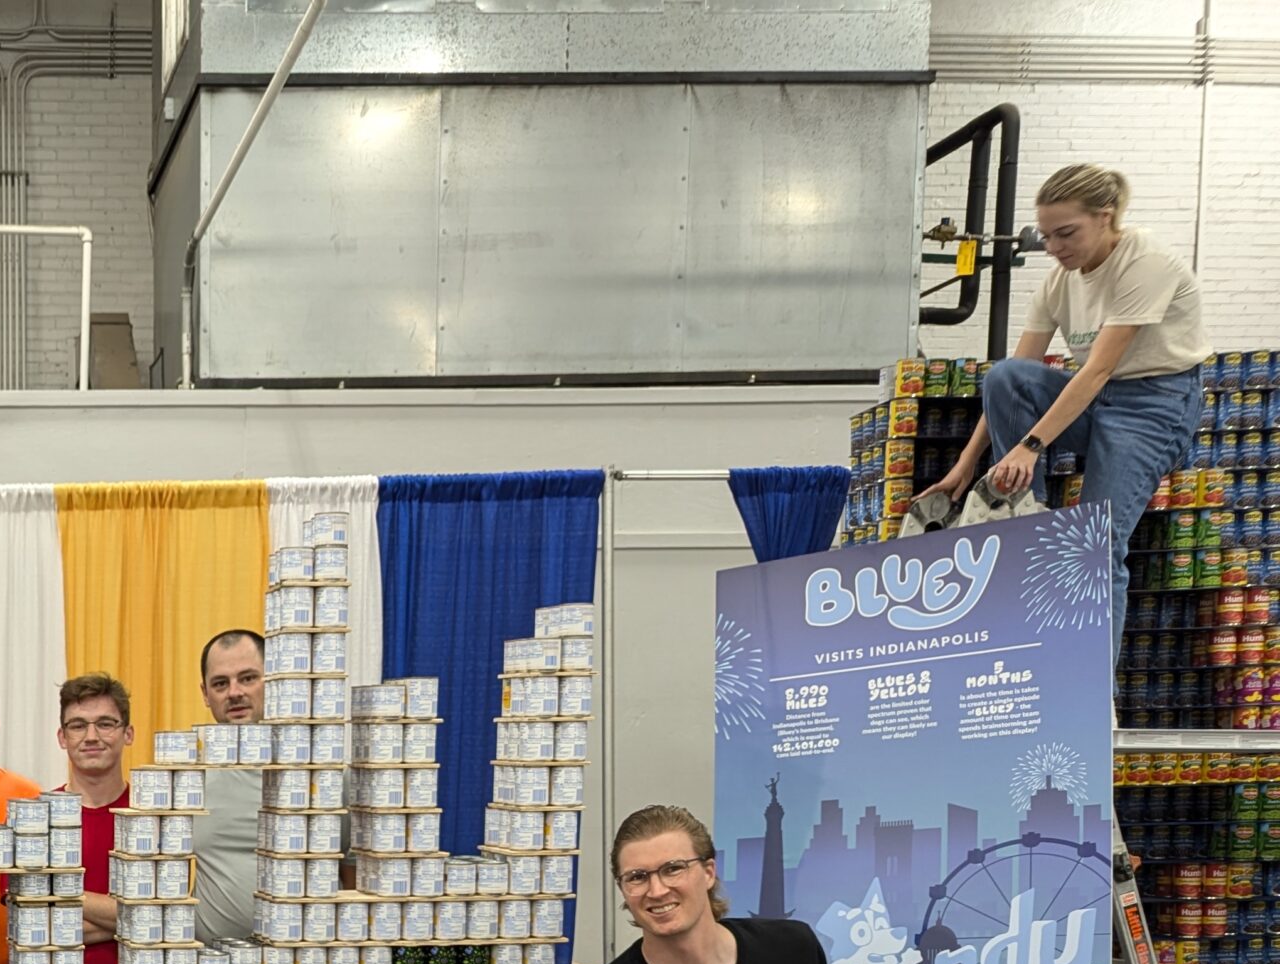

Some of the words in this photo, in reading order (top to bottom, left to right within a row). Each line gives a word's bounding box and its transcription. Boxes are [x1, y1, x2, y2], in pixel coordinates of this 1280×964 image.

[805, 535, 1000, 631] BLUEY
[815, 649, 864, 664] VISITS
[870, 630, 989, 657] INDIANAPOLIS
[994, 661, 1004, 674] 5
[868, 673, 915, 690] BLUES
[920, 670, 932, 683] &
[966, 670, 1032, 688] MONTHS
[785, 685, 828, 700] 8,990
[870, 683, 930, 701] YELLOW
[1014, 694, 1040, 702] episode
[975, 703, 1014, 716] BLUEY
[982, 720, 1027, 730] brainstorming
[961, 731, 988, 739] working
[1125, 906, 1144, 941] Little
